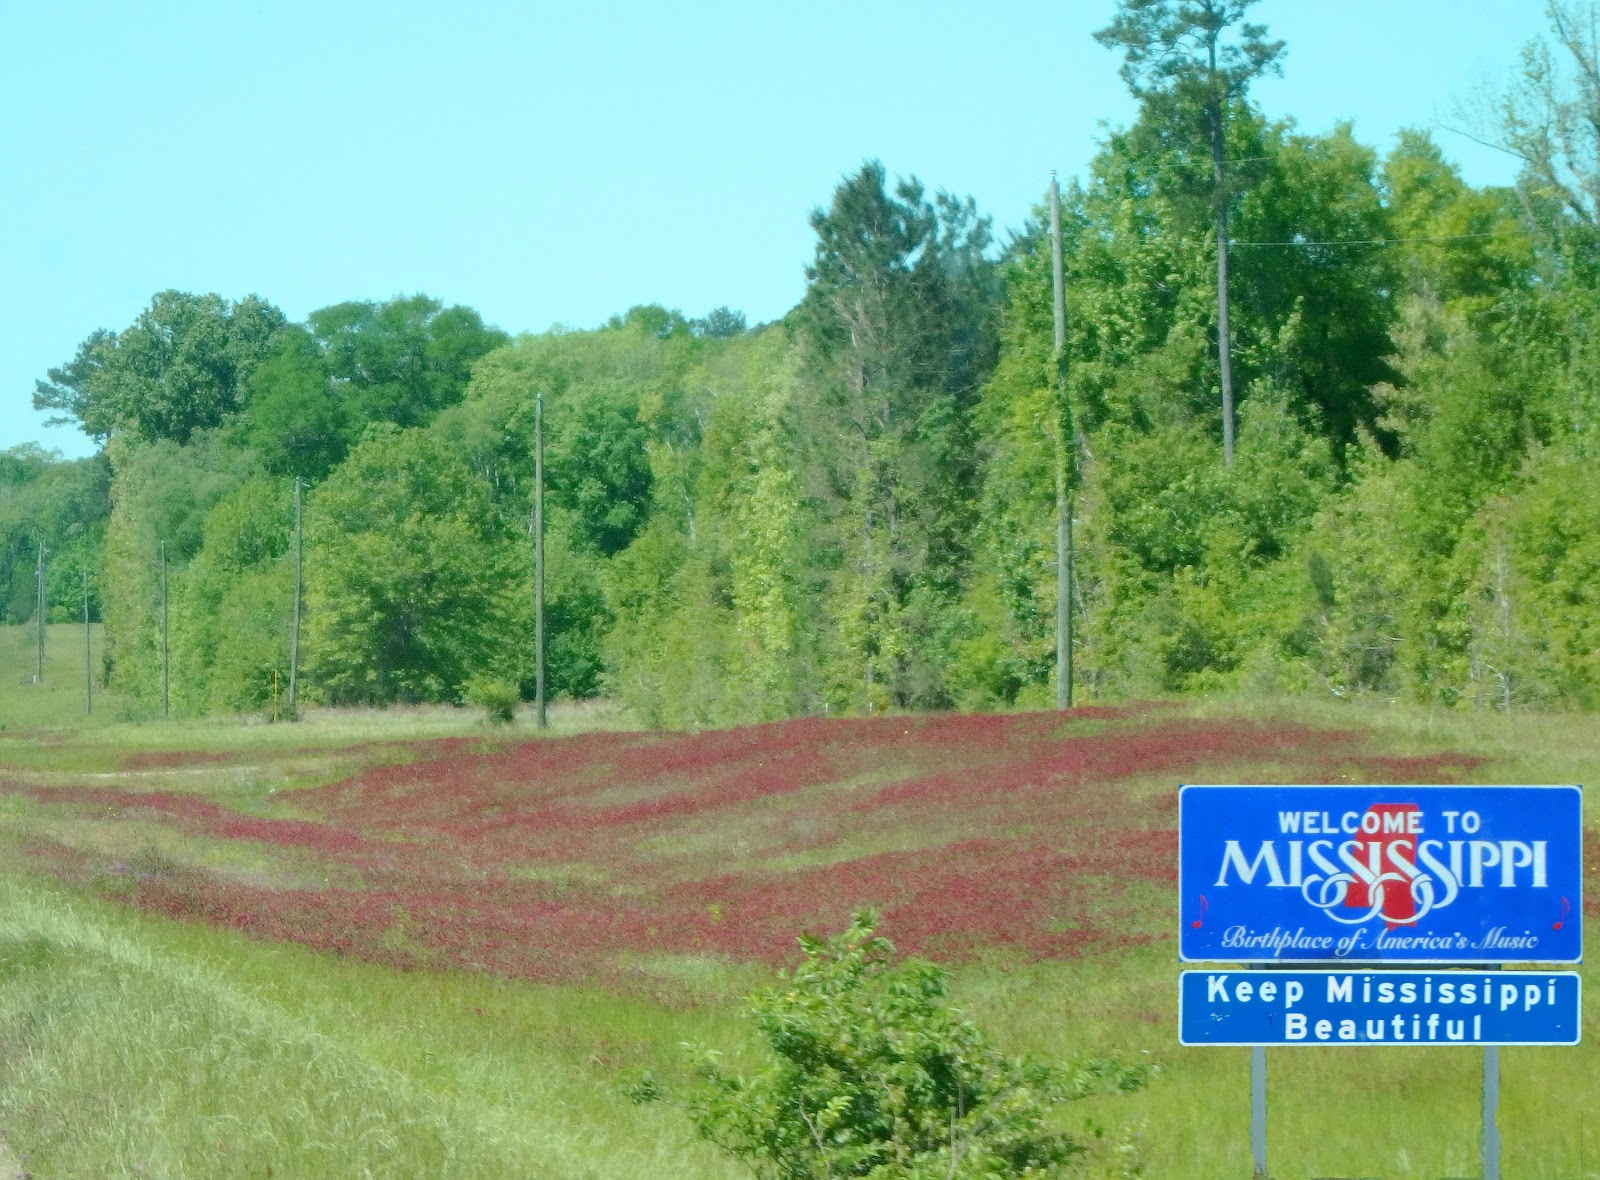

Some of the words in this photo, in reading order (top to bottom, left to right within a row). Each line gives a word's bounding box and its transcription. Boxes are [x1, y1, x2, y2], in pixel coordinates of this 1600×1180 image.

[1278, 811, 1425, 834] WELCOME
[1442, 811, 1481, 834] TO
[1213, 839, 1549, 924] MISSISSIPPI
[1221, 925, 1333, 957] Birthplace
[1335, 928, 1367, 957] of
[1361, 926, 1466, 951] America's
[1471, 930, 1539, 950] Music
[1206, 976, 1304, 1009] Keep
[1327, 976, 1557, 1011] Mississippi
[1285, 1013, 1482, 1041] Beautiful
